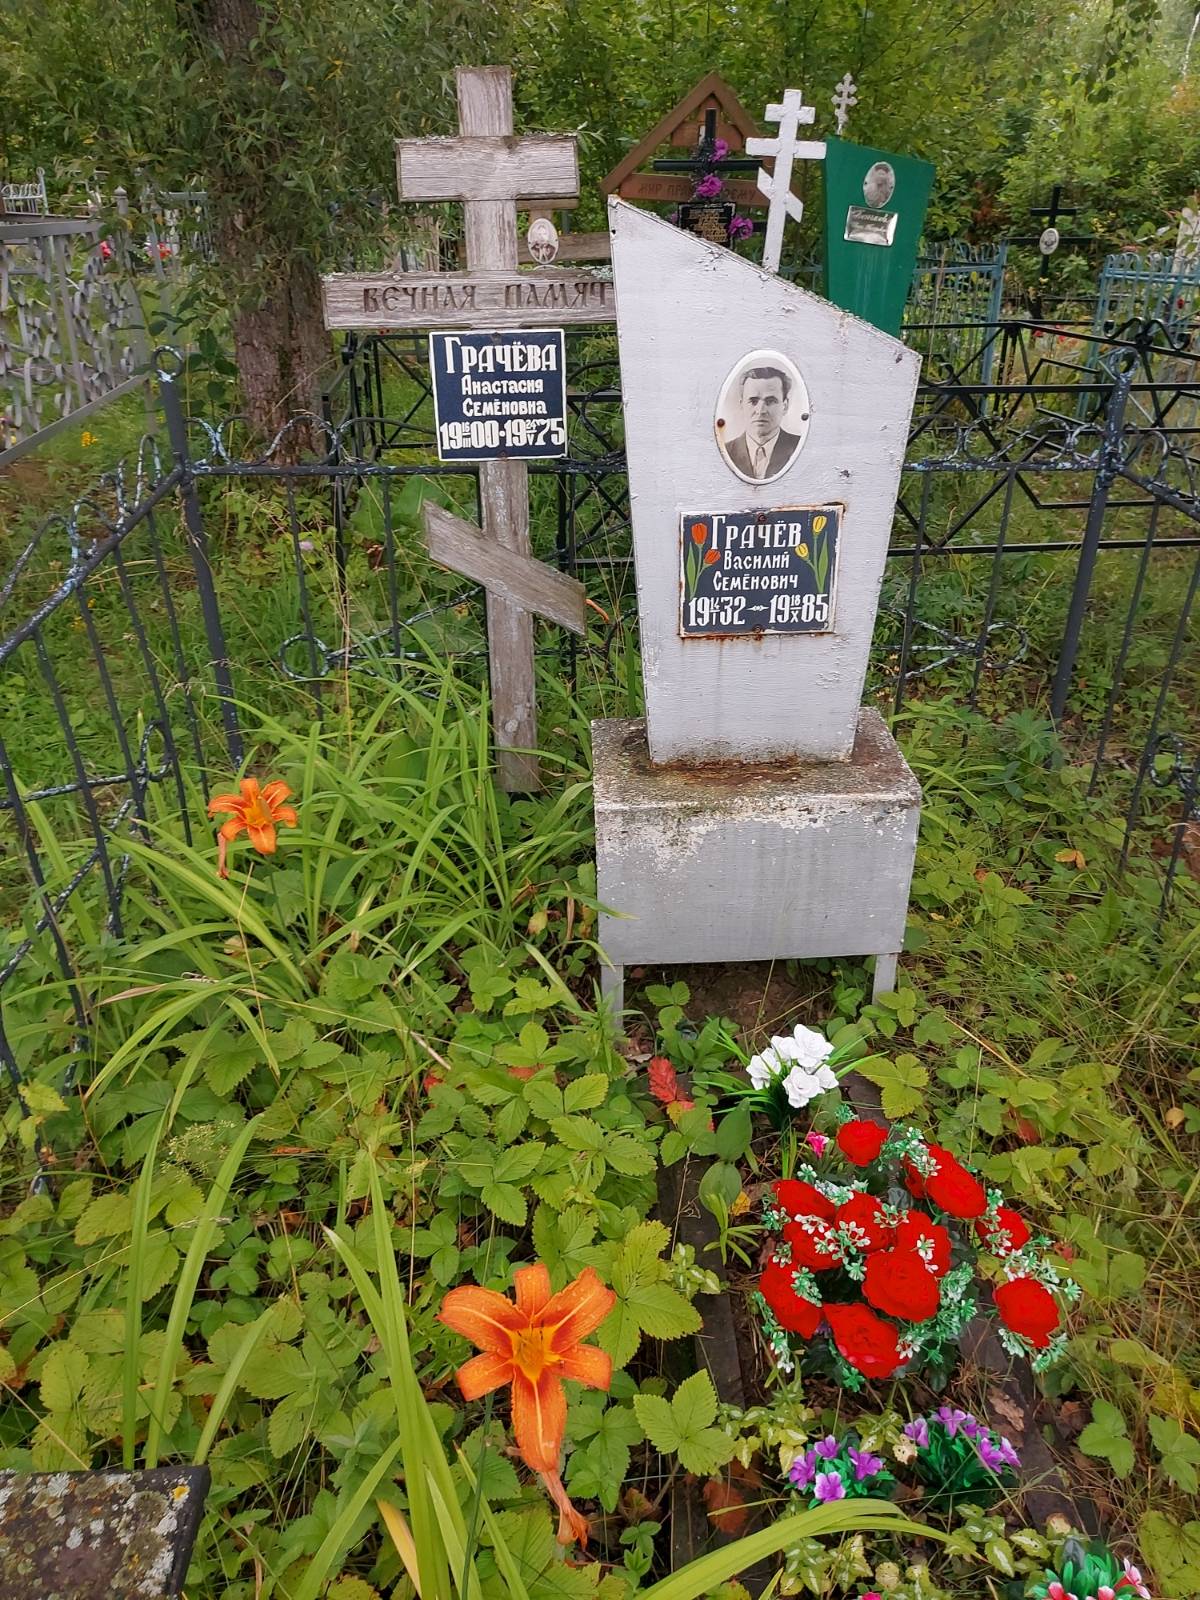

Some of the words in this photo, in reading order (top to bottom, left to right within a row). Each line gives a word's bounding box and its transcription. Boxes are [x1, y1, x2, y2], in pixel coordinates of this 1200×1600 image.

[363, 285, 478, 312] ВЕЧНАЯ
[504, 282, 608, 309] ПАМЯТ
[461, 374, 544, 396] Анастасия
[723, 550, 790, 570] Василий
